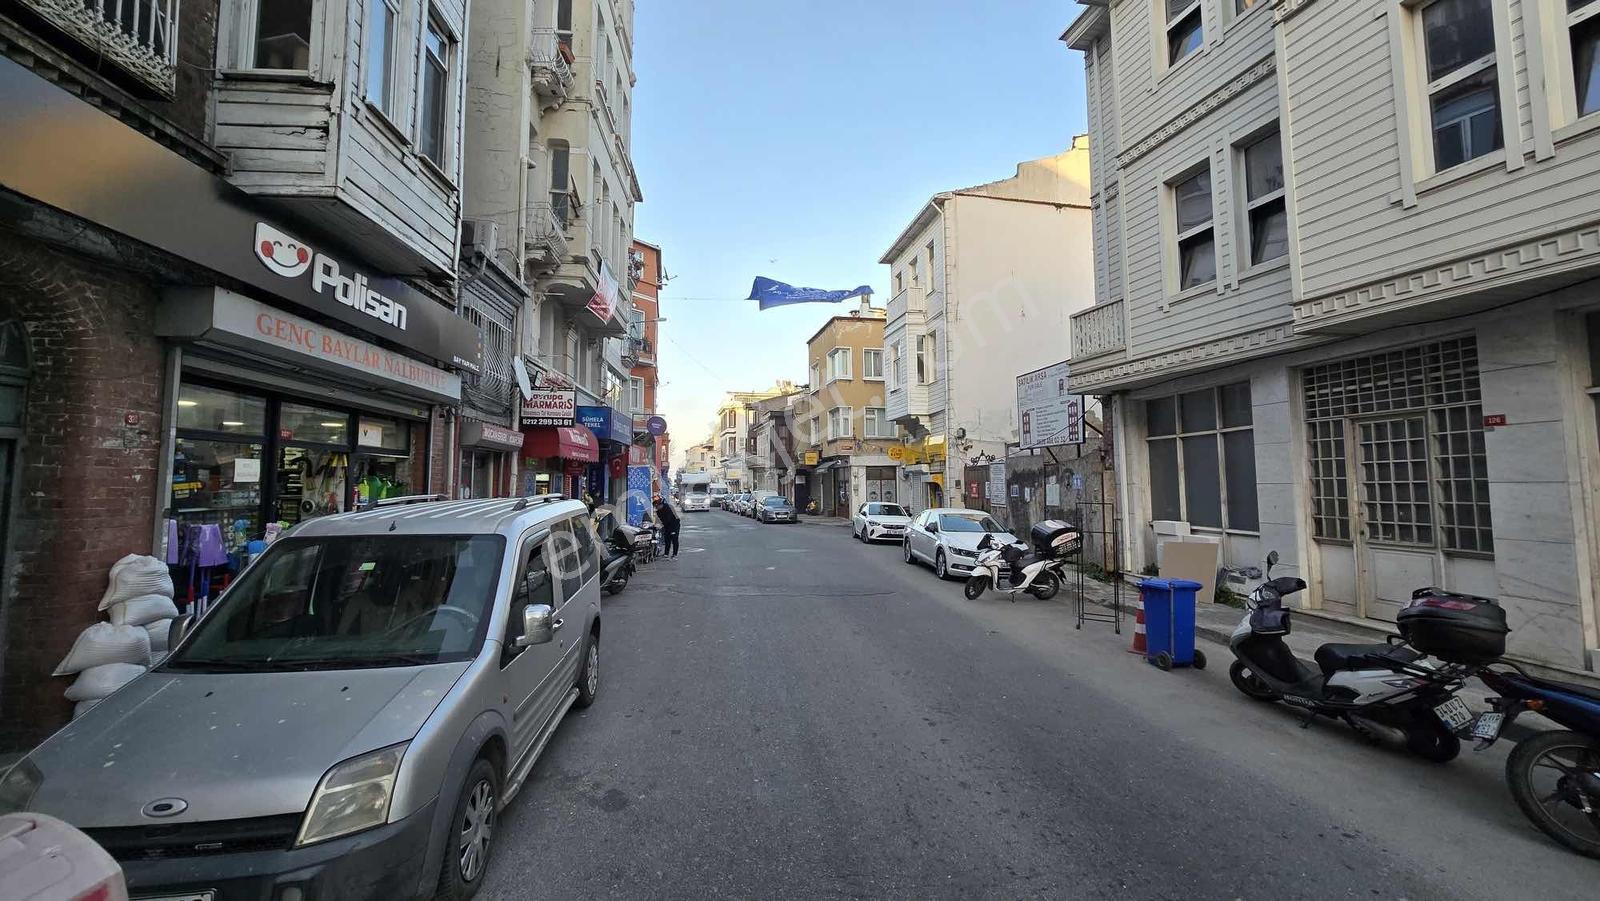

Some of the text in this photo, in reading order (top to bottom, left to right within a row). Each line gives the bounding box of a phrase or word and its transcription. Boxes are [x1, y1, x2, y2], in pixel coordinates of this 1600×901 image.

[312, 252, 408, 331] Polisan
[256, 313, 316, 351] GENÇ
[321, 334, 380, 369] BAYLAR
[553, 418, 563, 426] 53
[582, 415, 604, 423] SÜMELA
[1488, 416, 1502, 424] 126
[1449, 711, 1466, 725] 970
